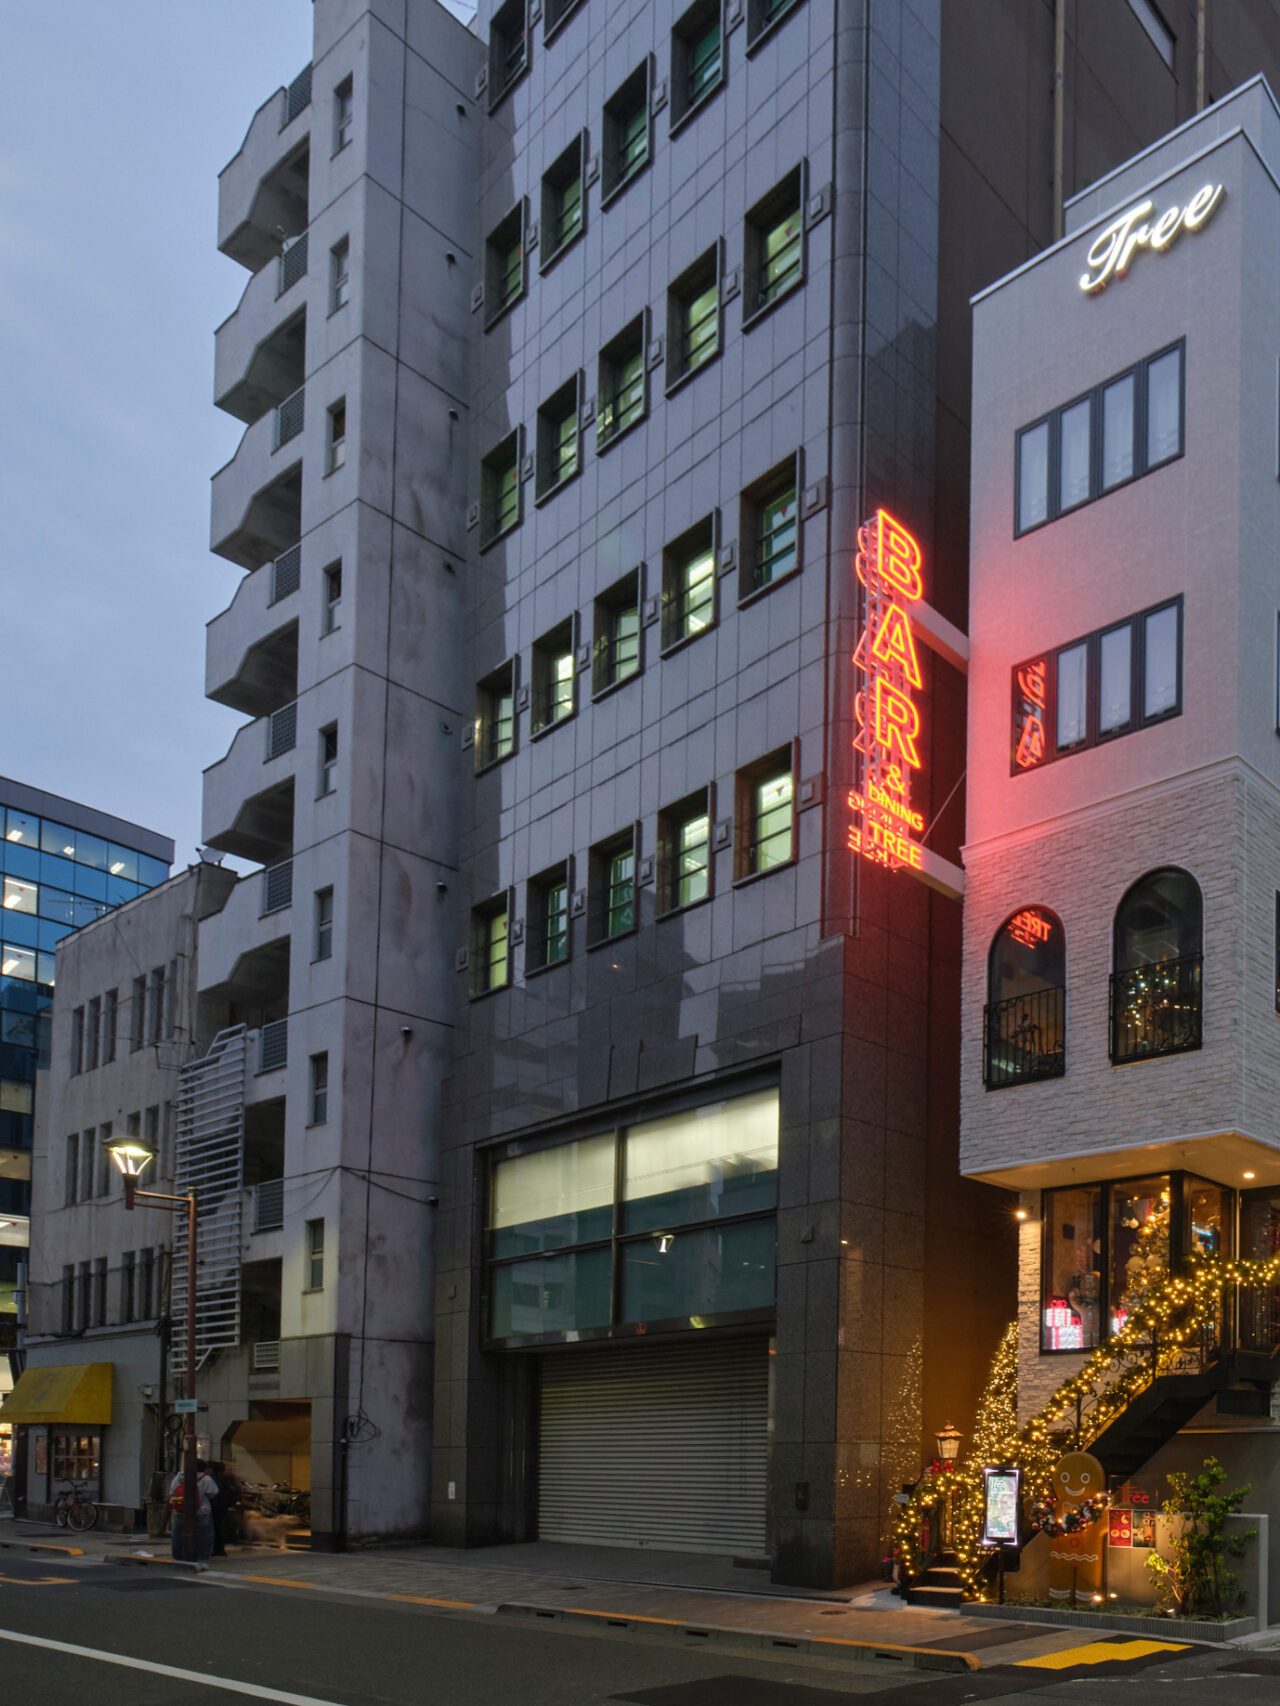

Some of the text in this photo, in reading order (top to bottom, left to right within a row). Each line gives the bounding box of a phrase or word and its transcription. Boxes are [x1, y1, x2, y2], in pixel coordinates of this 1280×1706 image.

[1079, 184, 1226, 294] Tree
[872, 508, 923, 769] BAR
[886, 764, 906, 796] &
[868, 820, 923, 870] TREE
[1117, 1486, 1150, 1504] Tree
